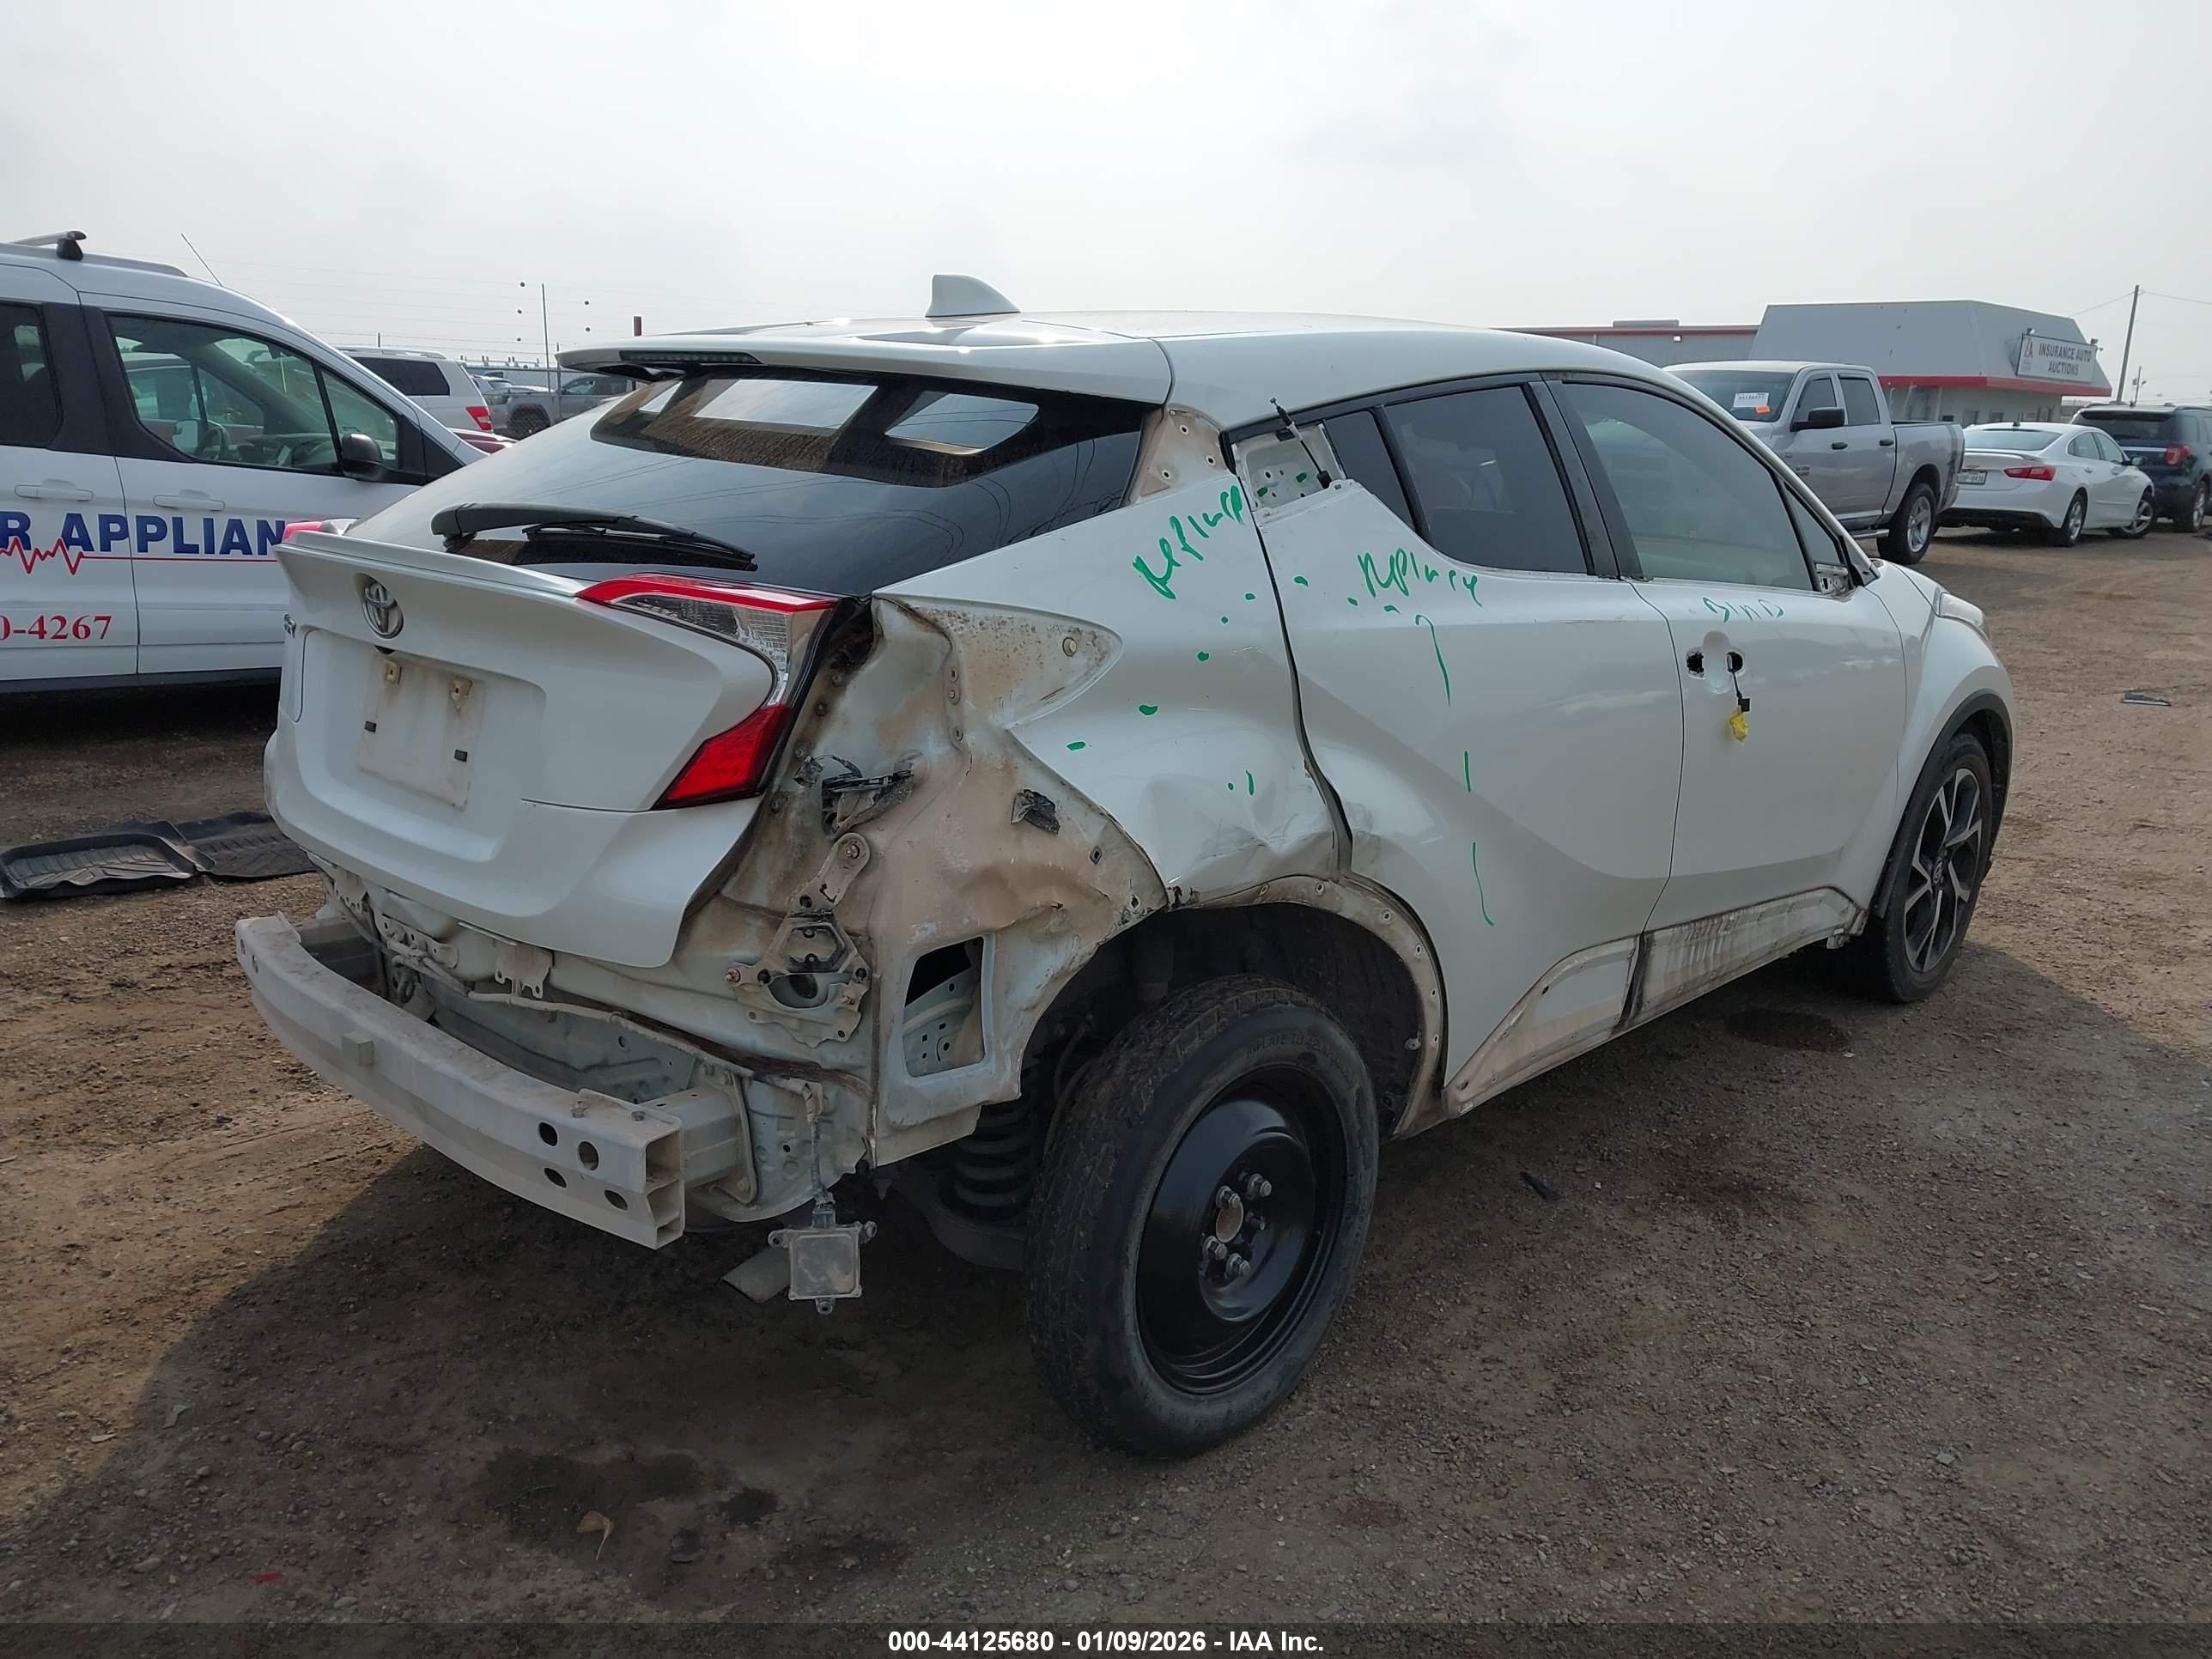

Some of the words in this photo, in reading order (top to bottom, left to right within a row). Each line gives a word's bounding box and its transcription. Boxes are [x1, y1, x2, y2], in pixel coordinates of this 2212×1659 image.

[2039, 343, 2075, 360] INSURANCE
[2075, 348, 2092, 362] AUTO
[2048, 361, 2080, 376] AUCTIONS
